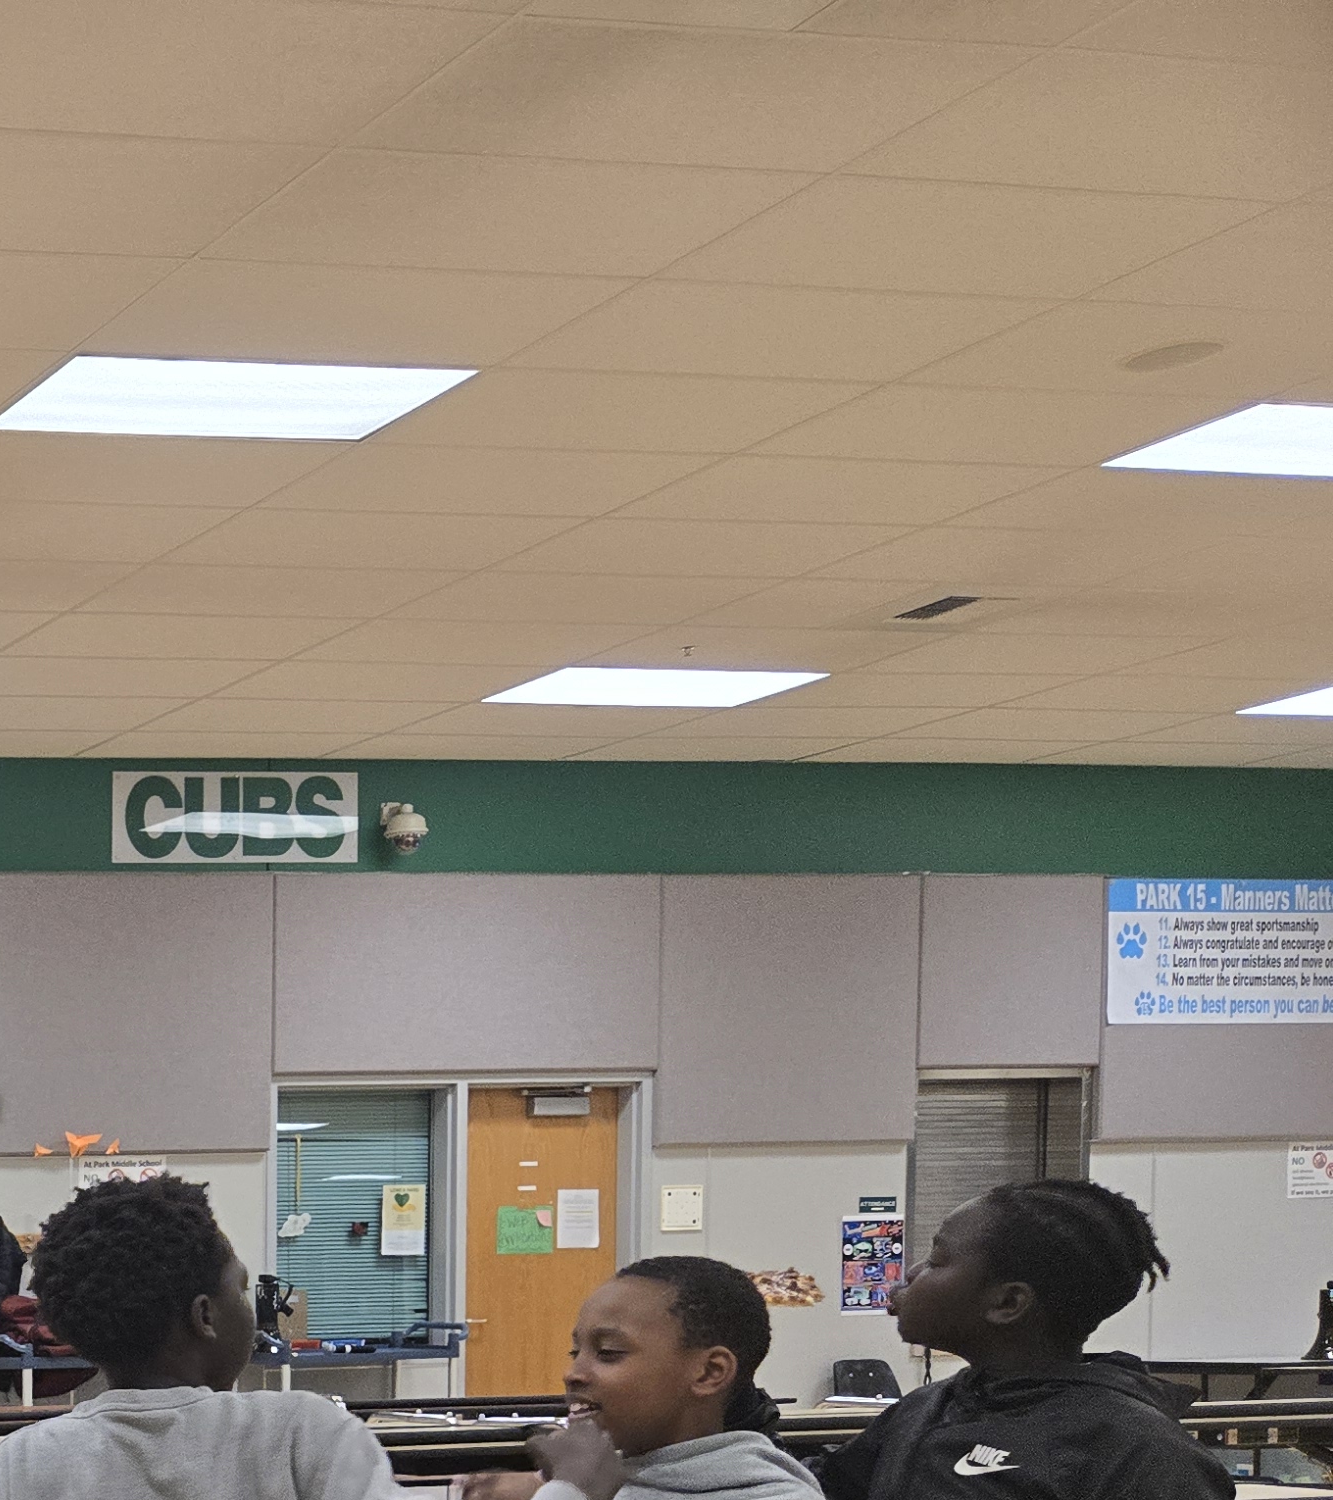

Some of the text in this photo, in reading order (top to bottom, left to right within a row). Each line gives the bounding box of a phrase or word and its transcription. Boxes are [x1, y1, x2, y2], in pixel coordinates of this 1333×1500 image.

[126, 775, 346, 859] CUBS
[1135, 882, 1183, 911] PARK
[1186, 882, 1207, 911] 15
[1220, 883, 1290, 911] Manners
[1173, 916, 1205, 936] Always
[1206, 917, 1229, 932] show
[1230, 917, 1254, 936] great
[1255, 917, 1320, 936] sportsmanship
[1173, 935, 1204, 953] Always
[1205, 935, 1261, 953] congratulate
[1262, 936, 1279, 950] and
[1281, 939, 1325, 953] encourage
[1172, 953, 1198, 968] Learn
[1199, 953, 1219, 968] from
[1220, 957, 1240, 972] your
[1241, 953, 1282, 968] mistakes
[1283, 953, 1300, 968] and
[1301, 957, 1322, 968] move
[1171, 972, 1185, 987] No
[1186, 972, 1215, 987] matter
[1216, 972, 1231, 987] the
[1232, 972, 1299, 990] circumstances,
[1300, 972, 1312, 987] be
[1158, 994, 1174, 1014] Be
[1177, 994, 1198, 1014] the
[1200, 994, 1227, 1014] best
[1229, 999, 1271, 1019] person
[1273, 999, 1294, 1019] you
[1297, 999, 1320, 1014] can
[93, 1160, 110, 1169] Park
[1291, 1156, 1305, 1166] NO
[967, 1443, 1012, 1467] NIKE
